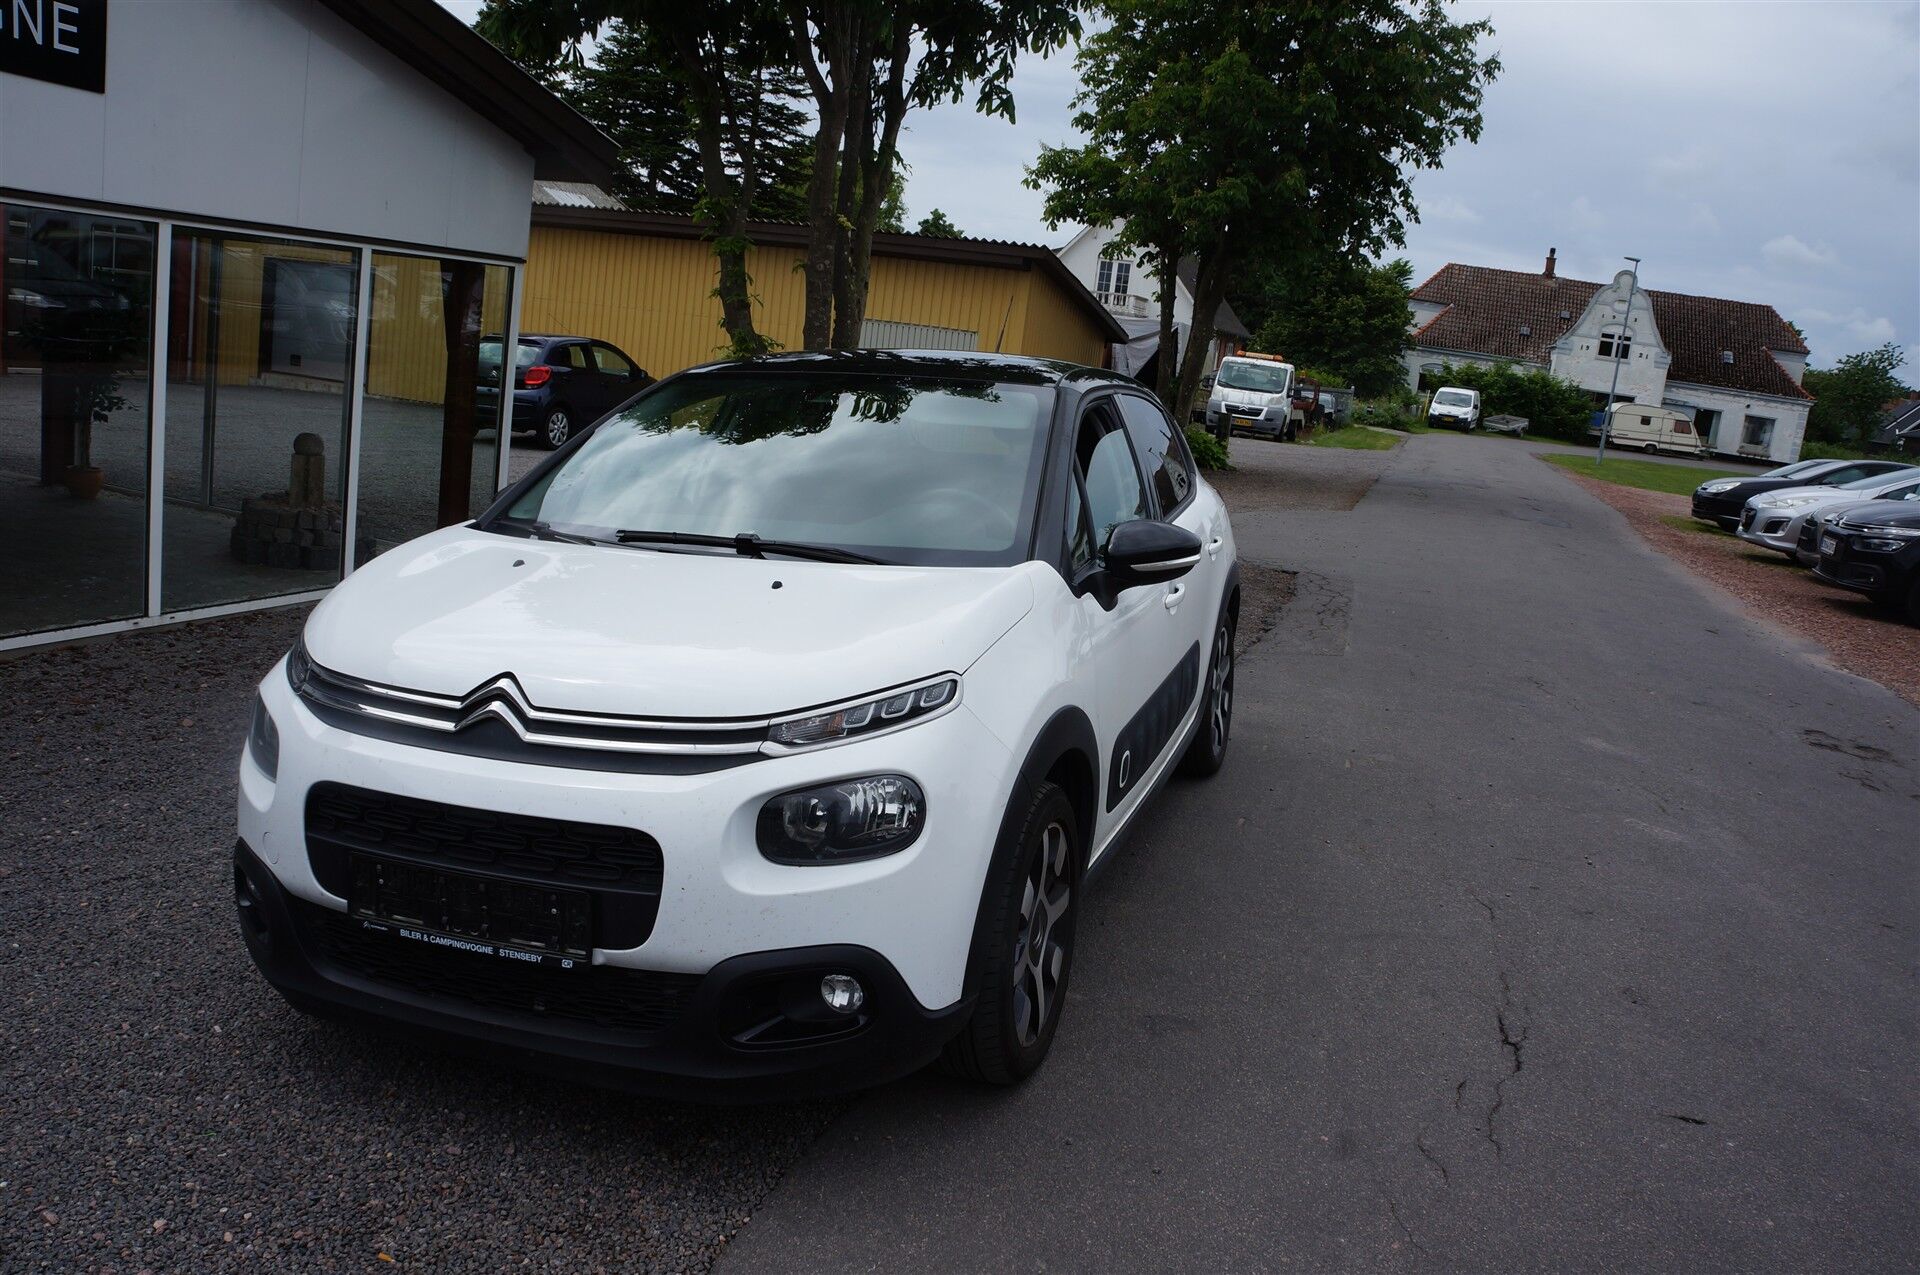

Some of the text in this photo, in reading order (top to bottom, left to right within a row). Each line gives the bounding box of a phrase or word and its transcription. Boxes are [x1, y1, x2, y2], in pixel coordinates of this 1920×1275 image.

[0, 0, 80, 55] NE
[400, 929, 542, 963] BILER & CAMPINGVOGNE STENSEBY
